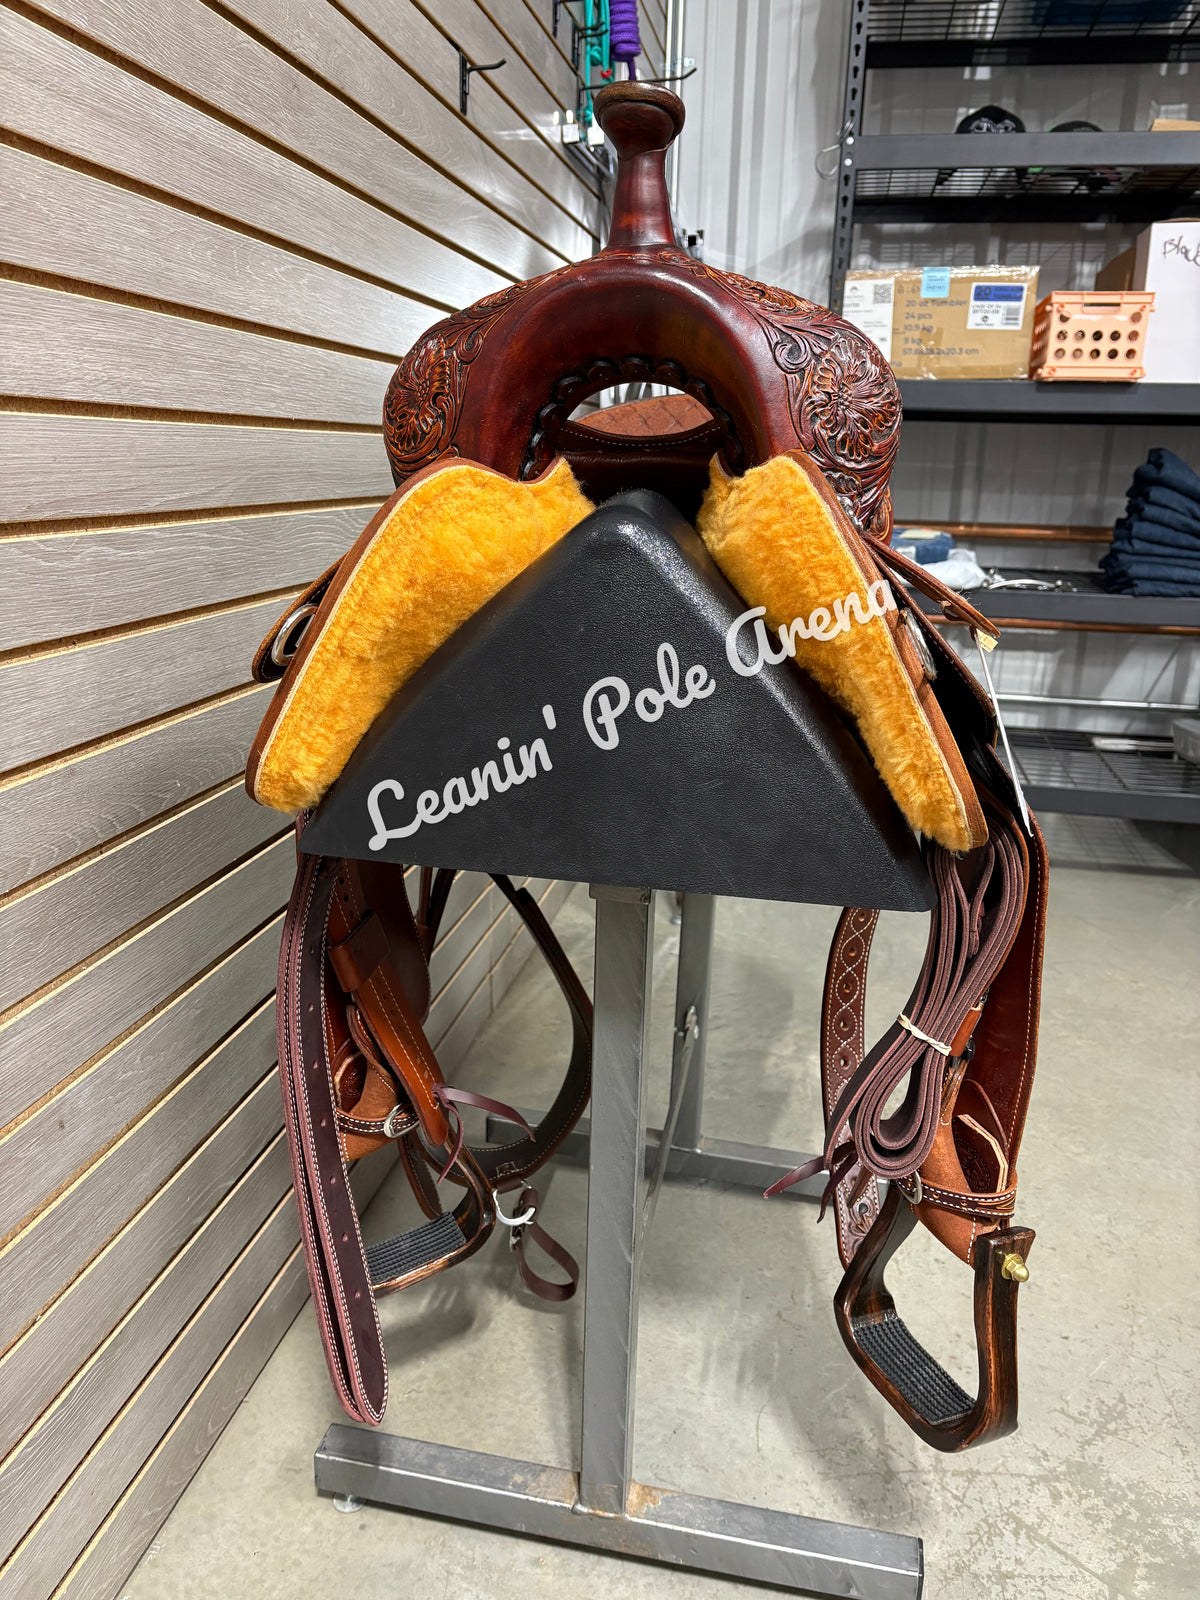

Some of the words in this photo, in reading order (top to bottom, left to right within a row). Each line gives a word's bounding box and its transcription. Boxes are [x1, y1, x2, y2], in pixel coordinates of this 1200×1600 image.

[931, 299, 968, 307] Tumbler
[917, 313, 933, 321] pcs
[922, 324, 934, 333] kg
[911, 337, 923, 346] kg
